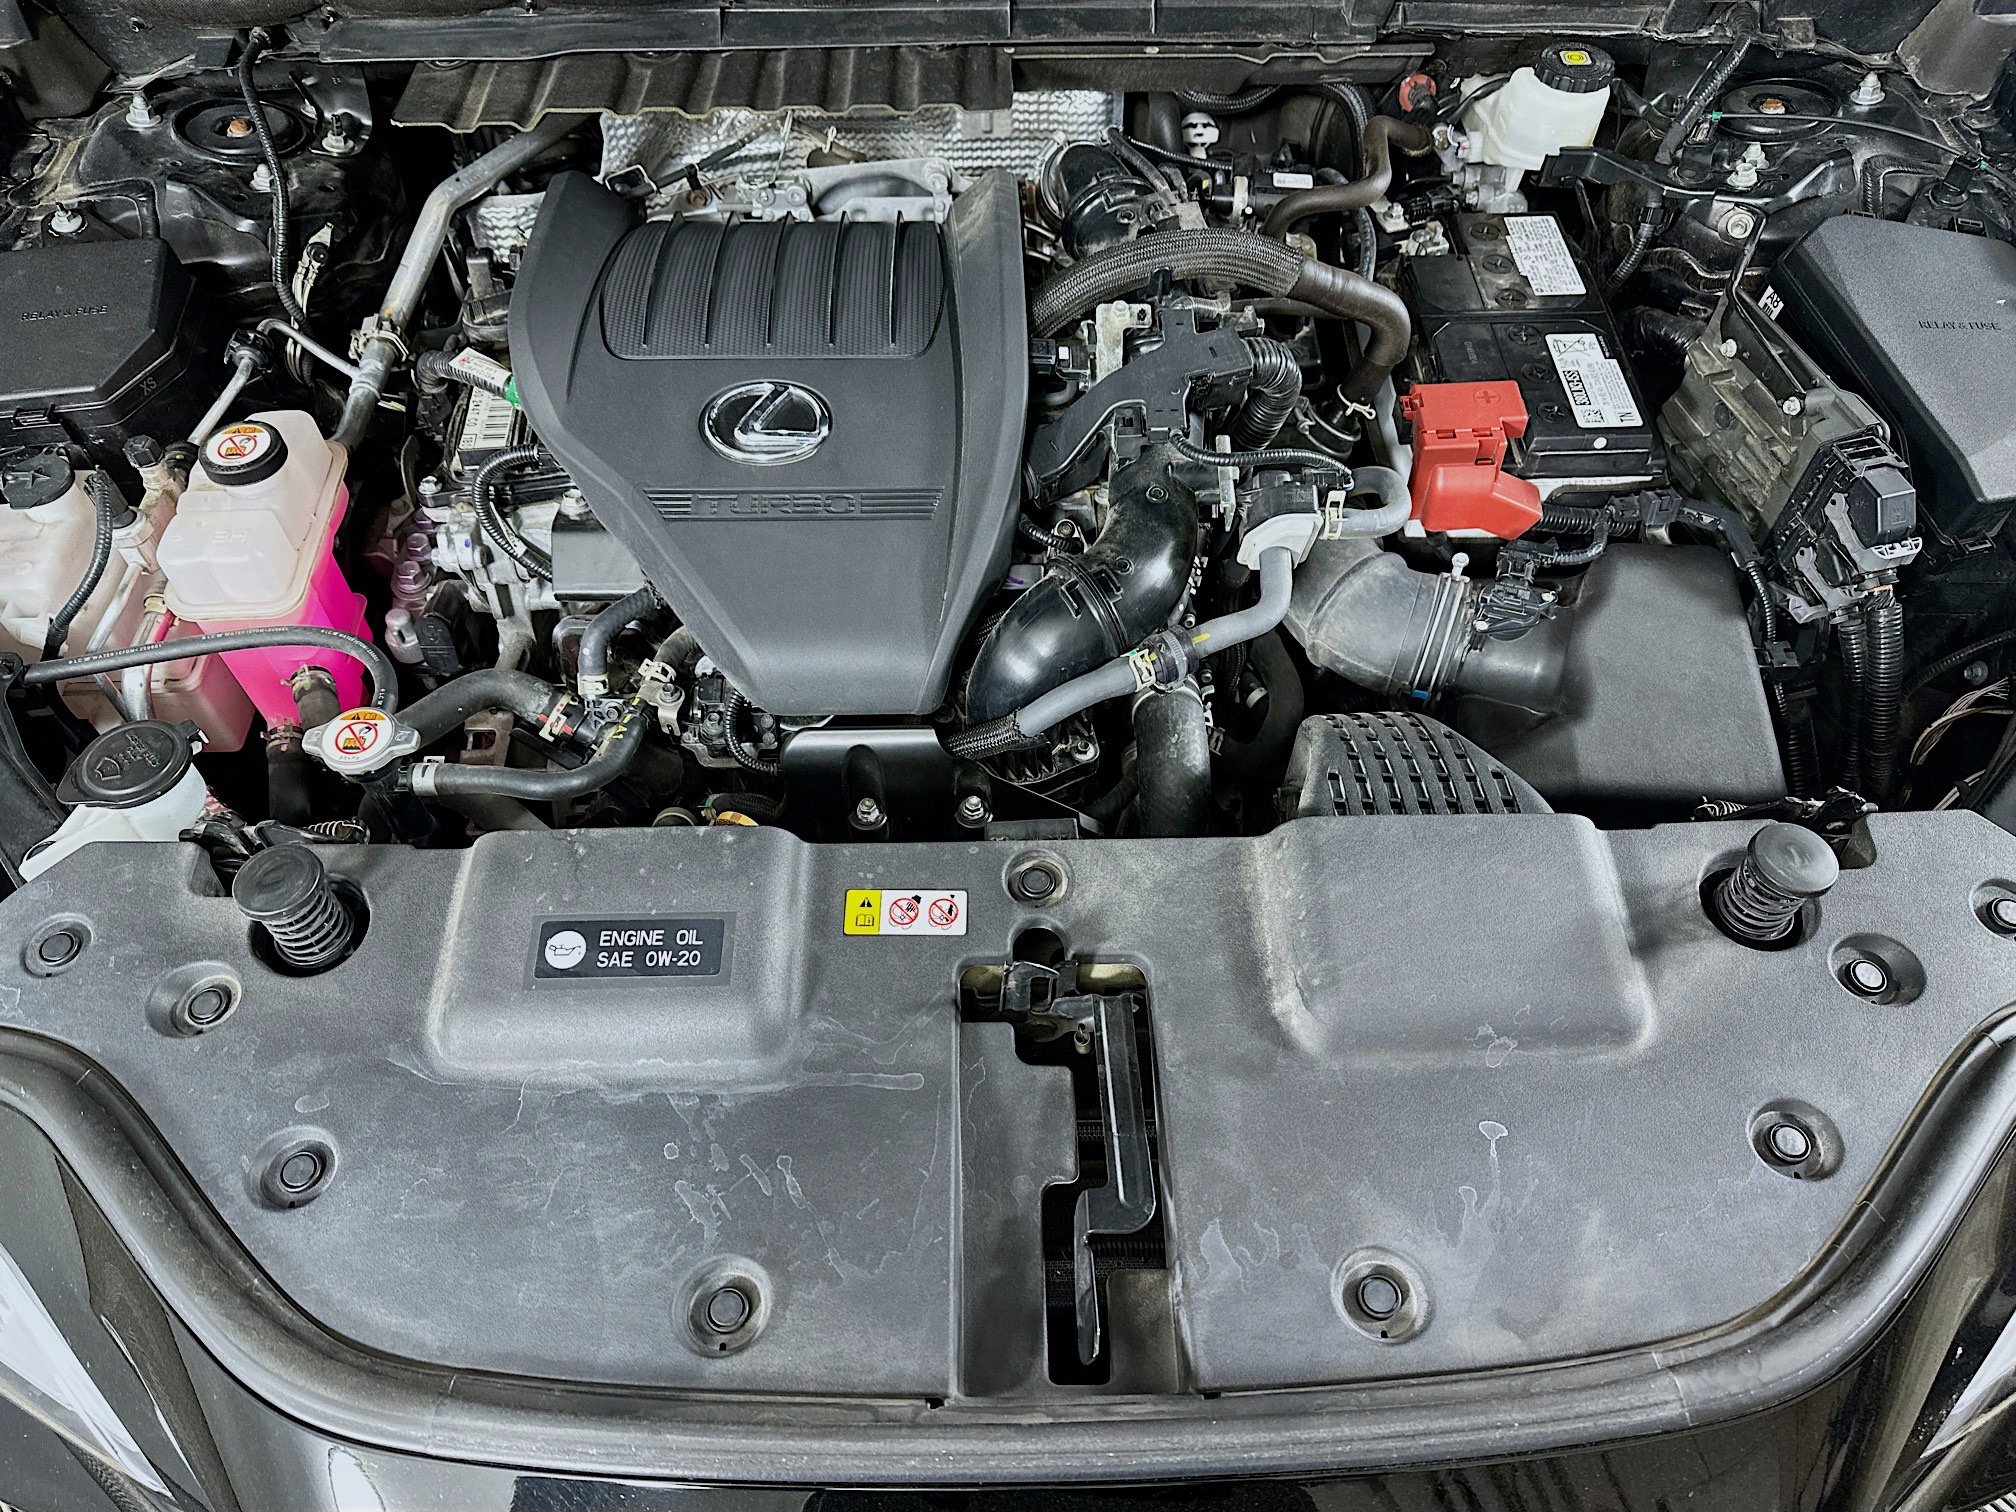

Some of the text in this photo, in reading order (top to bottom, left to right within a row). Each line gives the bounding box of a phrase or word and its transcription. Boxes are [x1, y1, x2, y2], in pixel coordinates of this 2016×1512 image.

[20, 310, 61, 321] RELAY
[75, 305, 108, 317] FUSE
[1918, 320, 1956, 330] RELAY
[1968, 321, 2001, 331] FUSE
[139, 376, 157, 396] XS
[697, 493, 856, 514] TURBO
[92, 652, 114, 661] WATER
[599, 929, 704, 947] ENGINE OIL
[596, 950, 701, 968] SAE 0W-20
